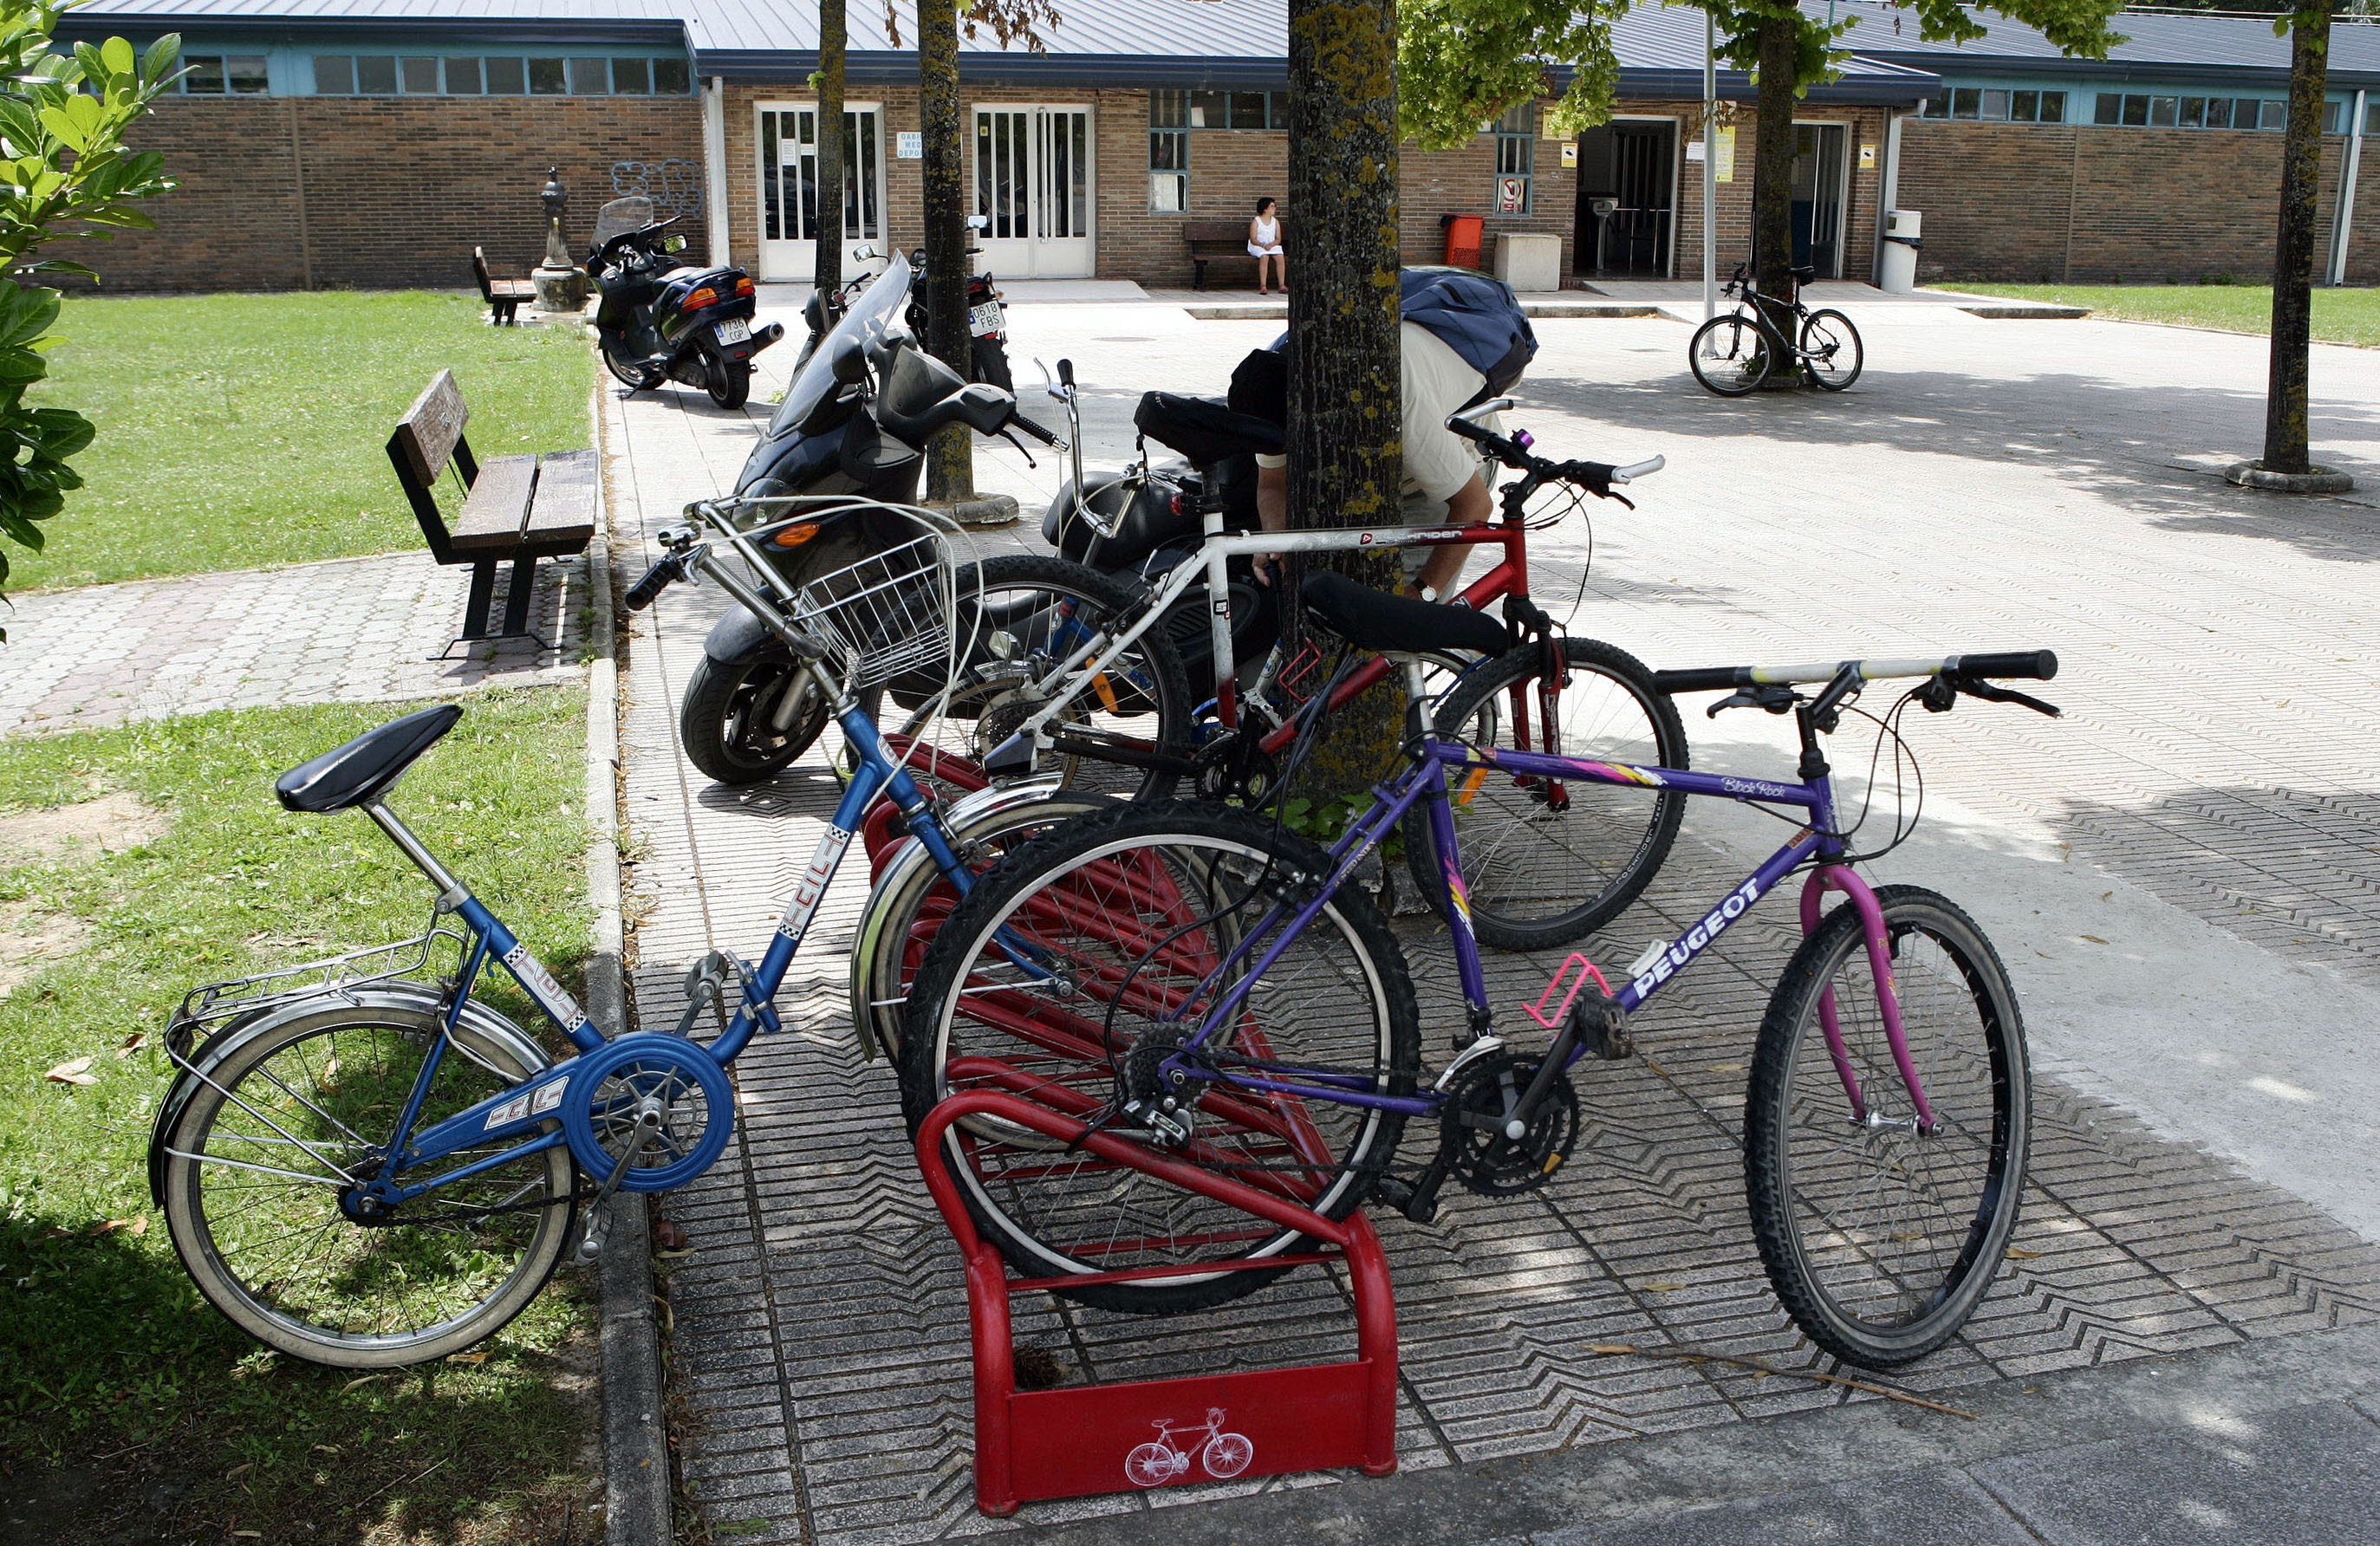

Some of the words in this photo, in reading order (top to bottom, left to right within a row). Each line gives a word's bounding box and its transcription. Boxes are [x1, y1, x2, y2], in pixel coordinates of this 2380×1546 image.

[972, 302, 998, 319] 0618
[720, 319, 744, 332] 7736
[980, 314, 999, 328] FBS
[729, 329, 744, 341] CGP
[1756, 781, 1785, 797] Rock
[794, 861, 832, 908] CIL
[1632, 877, 1760, 1000] PEUGEOT
